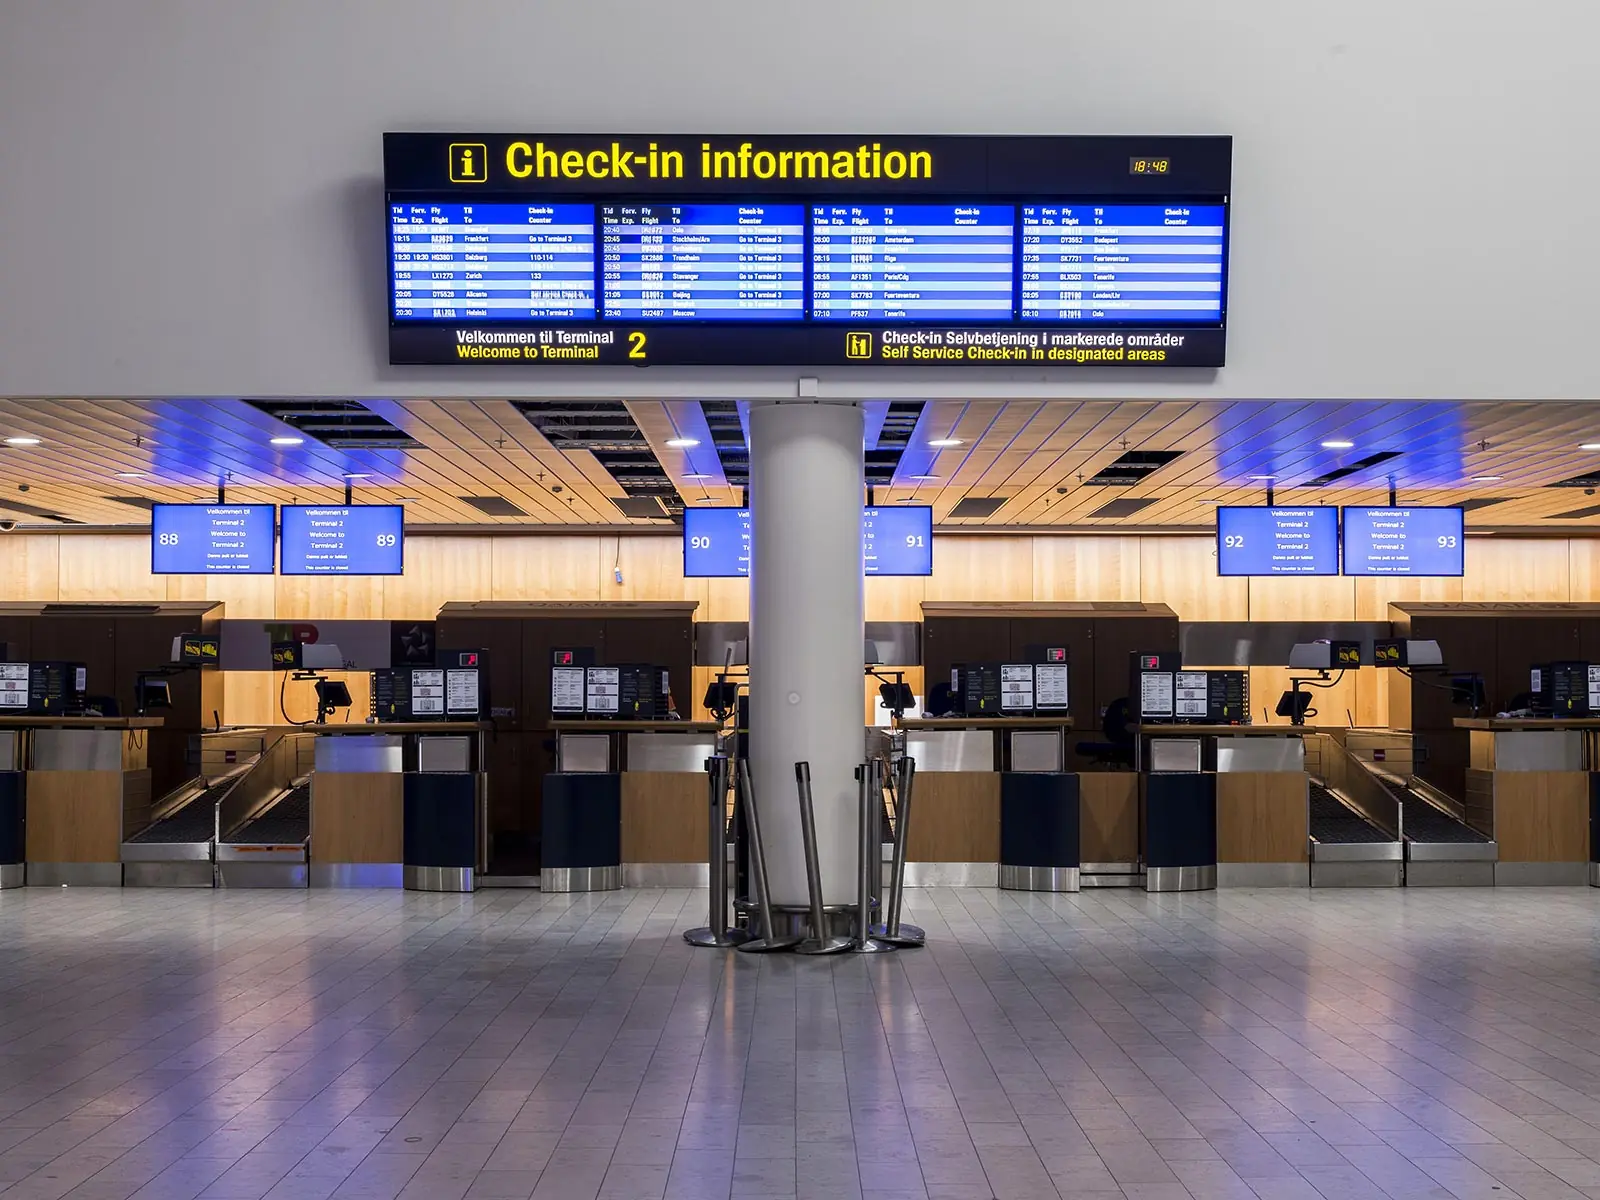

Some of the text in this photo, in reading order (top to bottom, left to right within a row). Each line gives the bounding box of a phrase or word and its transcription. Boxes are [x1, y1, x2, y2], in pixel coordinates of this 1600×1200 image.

[506, 142, 931, 179] Check-in information
[1134, 161, 1167, 173] 18:48
[431, 207, 441, 215] Fly
[642, 208, 651, 216] Fly
[852, 208, 862, 216] Fly
[1062, 208, 1072, 216] Fly
[432, 217, 449, 225] Flight
[622, 217, 635, 225] Exp.
[642, 217, 659, 225] Flight
[832, 218, 845, 226] Exp.
[852, 218, 869, 226] Flight
[1042, 218, 1055, 226] Exp.
[1062, 218, 1079, 226] Flight
[456, 330, 613, 344] Velkommen til Terminal
[882, 331, 1184, 346] Check-in Selvbetjening i markerede områder
[629, 332, 646, 358] 2
[457, 345, 598, 358] Welcome to Terminal
[882, 346, 1165, 362] Self Service Check-in in designated areas
[160, 533, 178, 545] 88
[376, 534, 395, 547] 89
[691, 536, 710, 549] 90
[906, 535, 924, 547] 91
[1225, 535, 1244, 547] 92
[1437, 536, 1456, 548] 93
